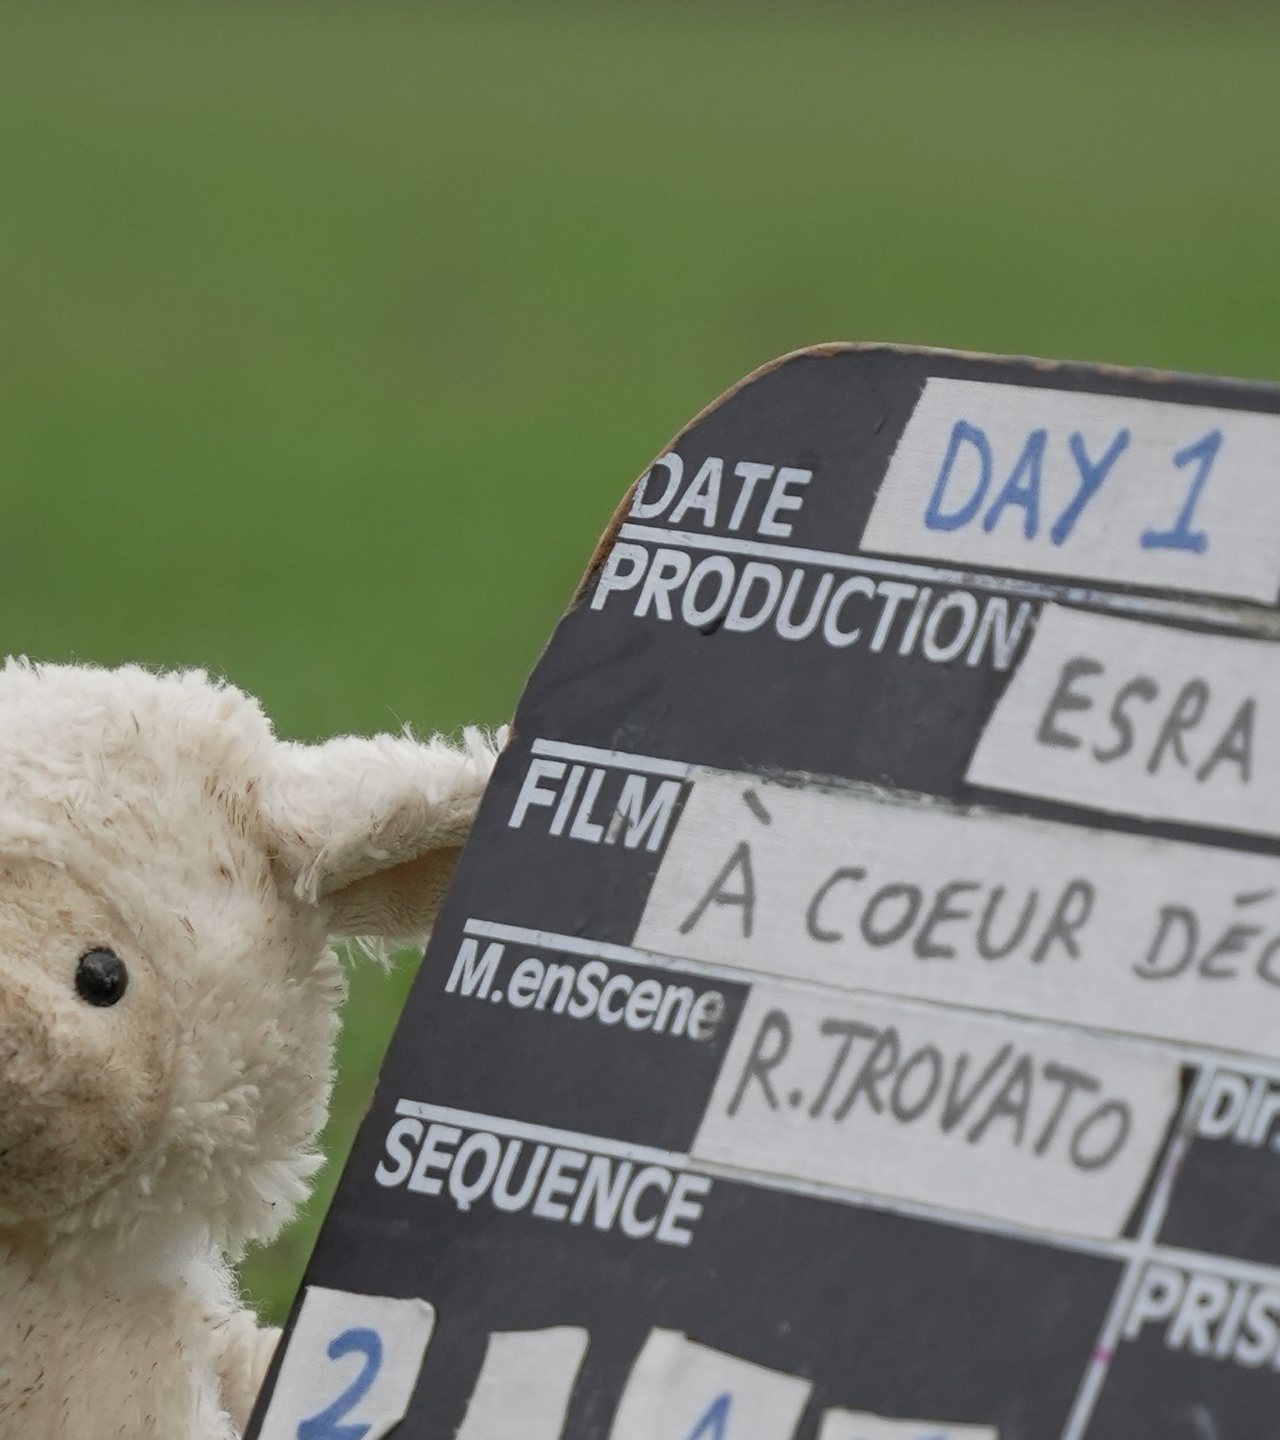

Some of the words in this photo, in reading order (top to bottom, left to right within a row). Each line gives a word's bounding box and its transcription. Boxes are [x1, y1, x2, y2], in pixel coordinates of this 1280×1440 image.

[631, 451, 812, 537] DATE
[923, 418, 1130, 546] DAY
[1140, 428, 1223, 553] 1
[590, 541, 1033, 670] PRODUCTION
[1035, 656, 1258, 784] ESRA
[508, 759, 682, 853] FILM
[680, 788, 772, 937] À
[805, 866, 1096, 964] COEUR
[444, 937, 727, 1043] M.enScene
[726, 1007, 1132, 1170] R.TROVATO
[374, 1118, 712, 1247] SEQUENCE
